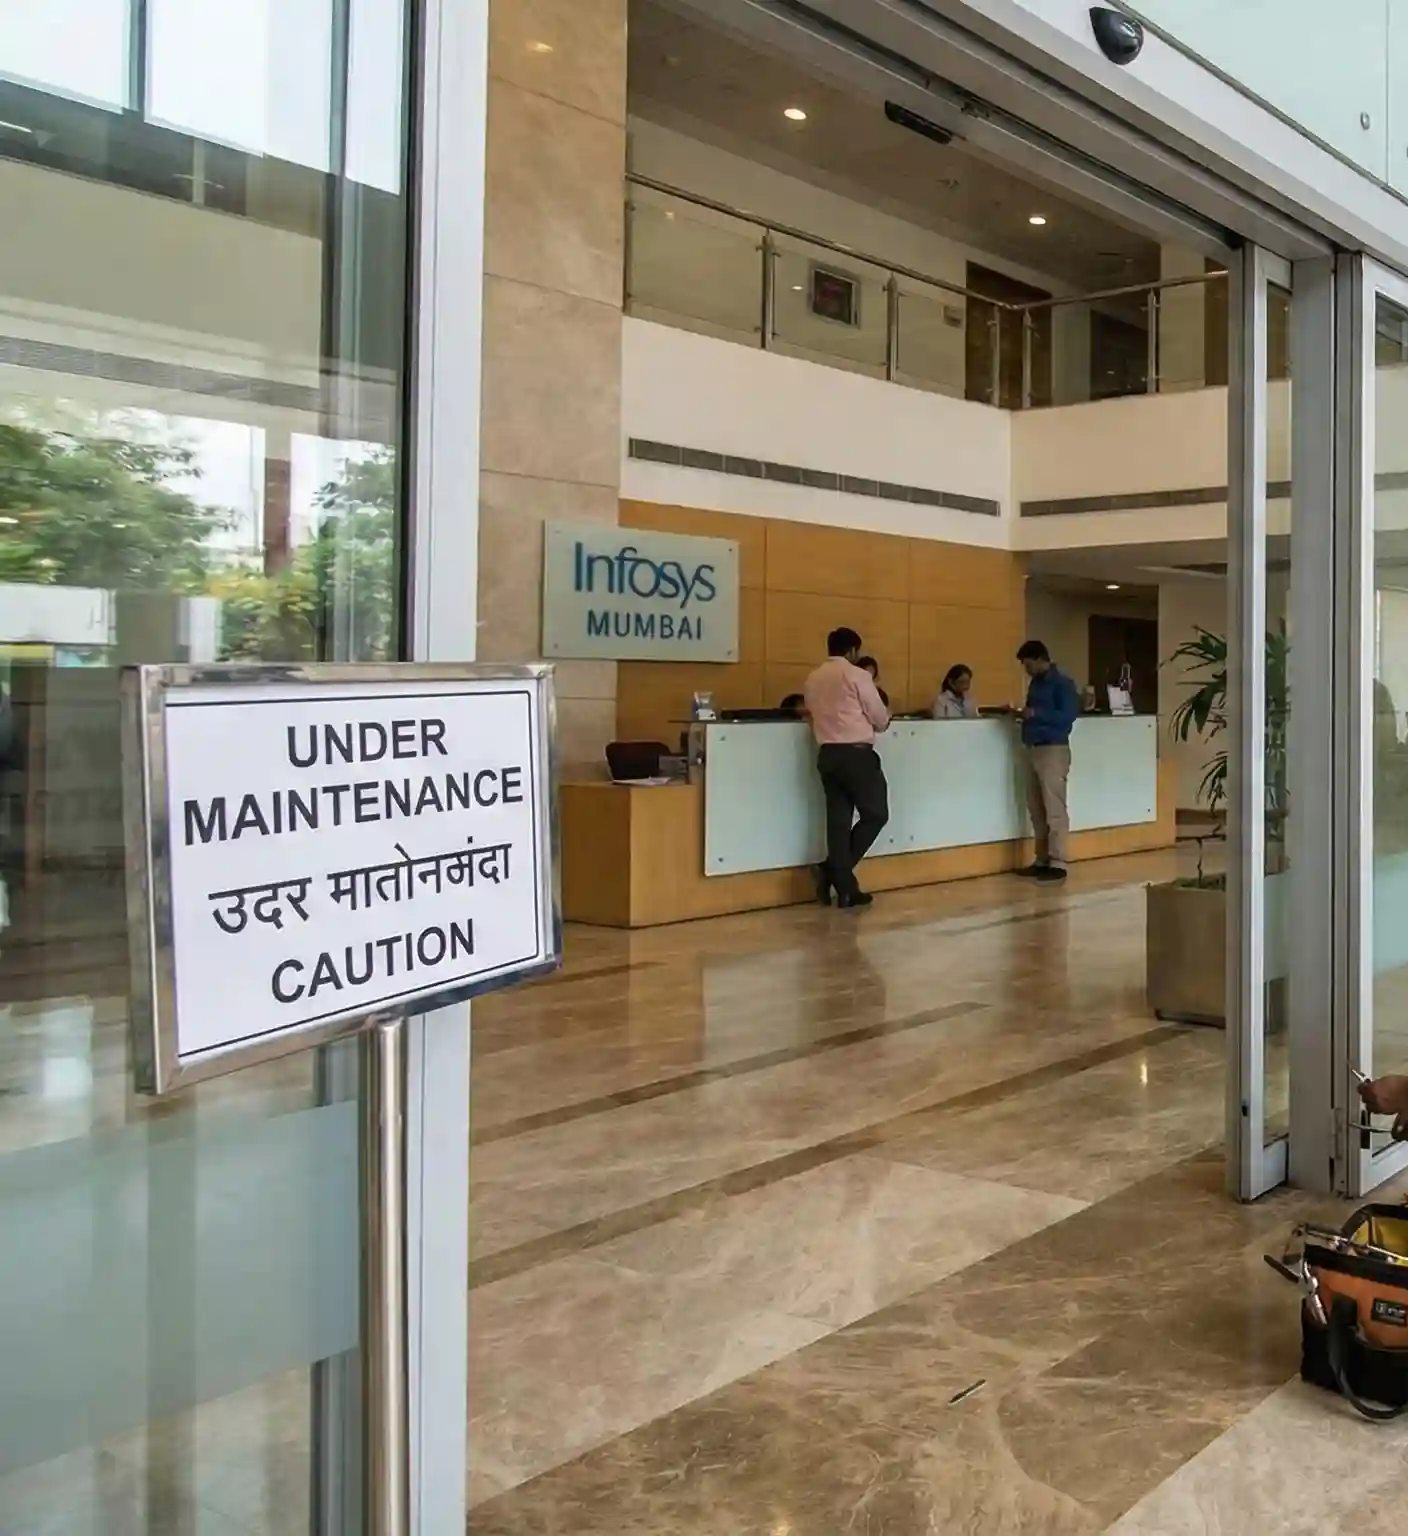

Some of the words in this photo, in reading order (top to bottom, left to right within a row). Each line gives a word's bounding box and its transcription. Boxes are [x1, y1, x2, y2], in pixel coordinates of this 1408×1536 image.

[574, 541, 716, 609] Infosys
[586, 609, 703, 641] MUMBAI
[287, 718, 448, 768] UNDER
[184, 766, 524, 846] MAINTENANCE
[208, 876, 313, 934] उदर
[271, 918, 475, 1003] CAUTION
